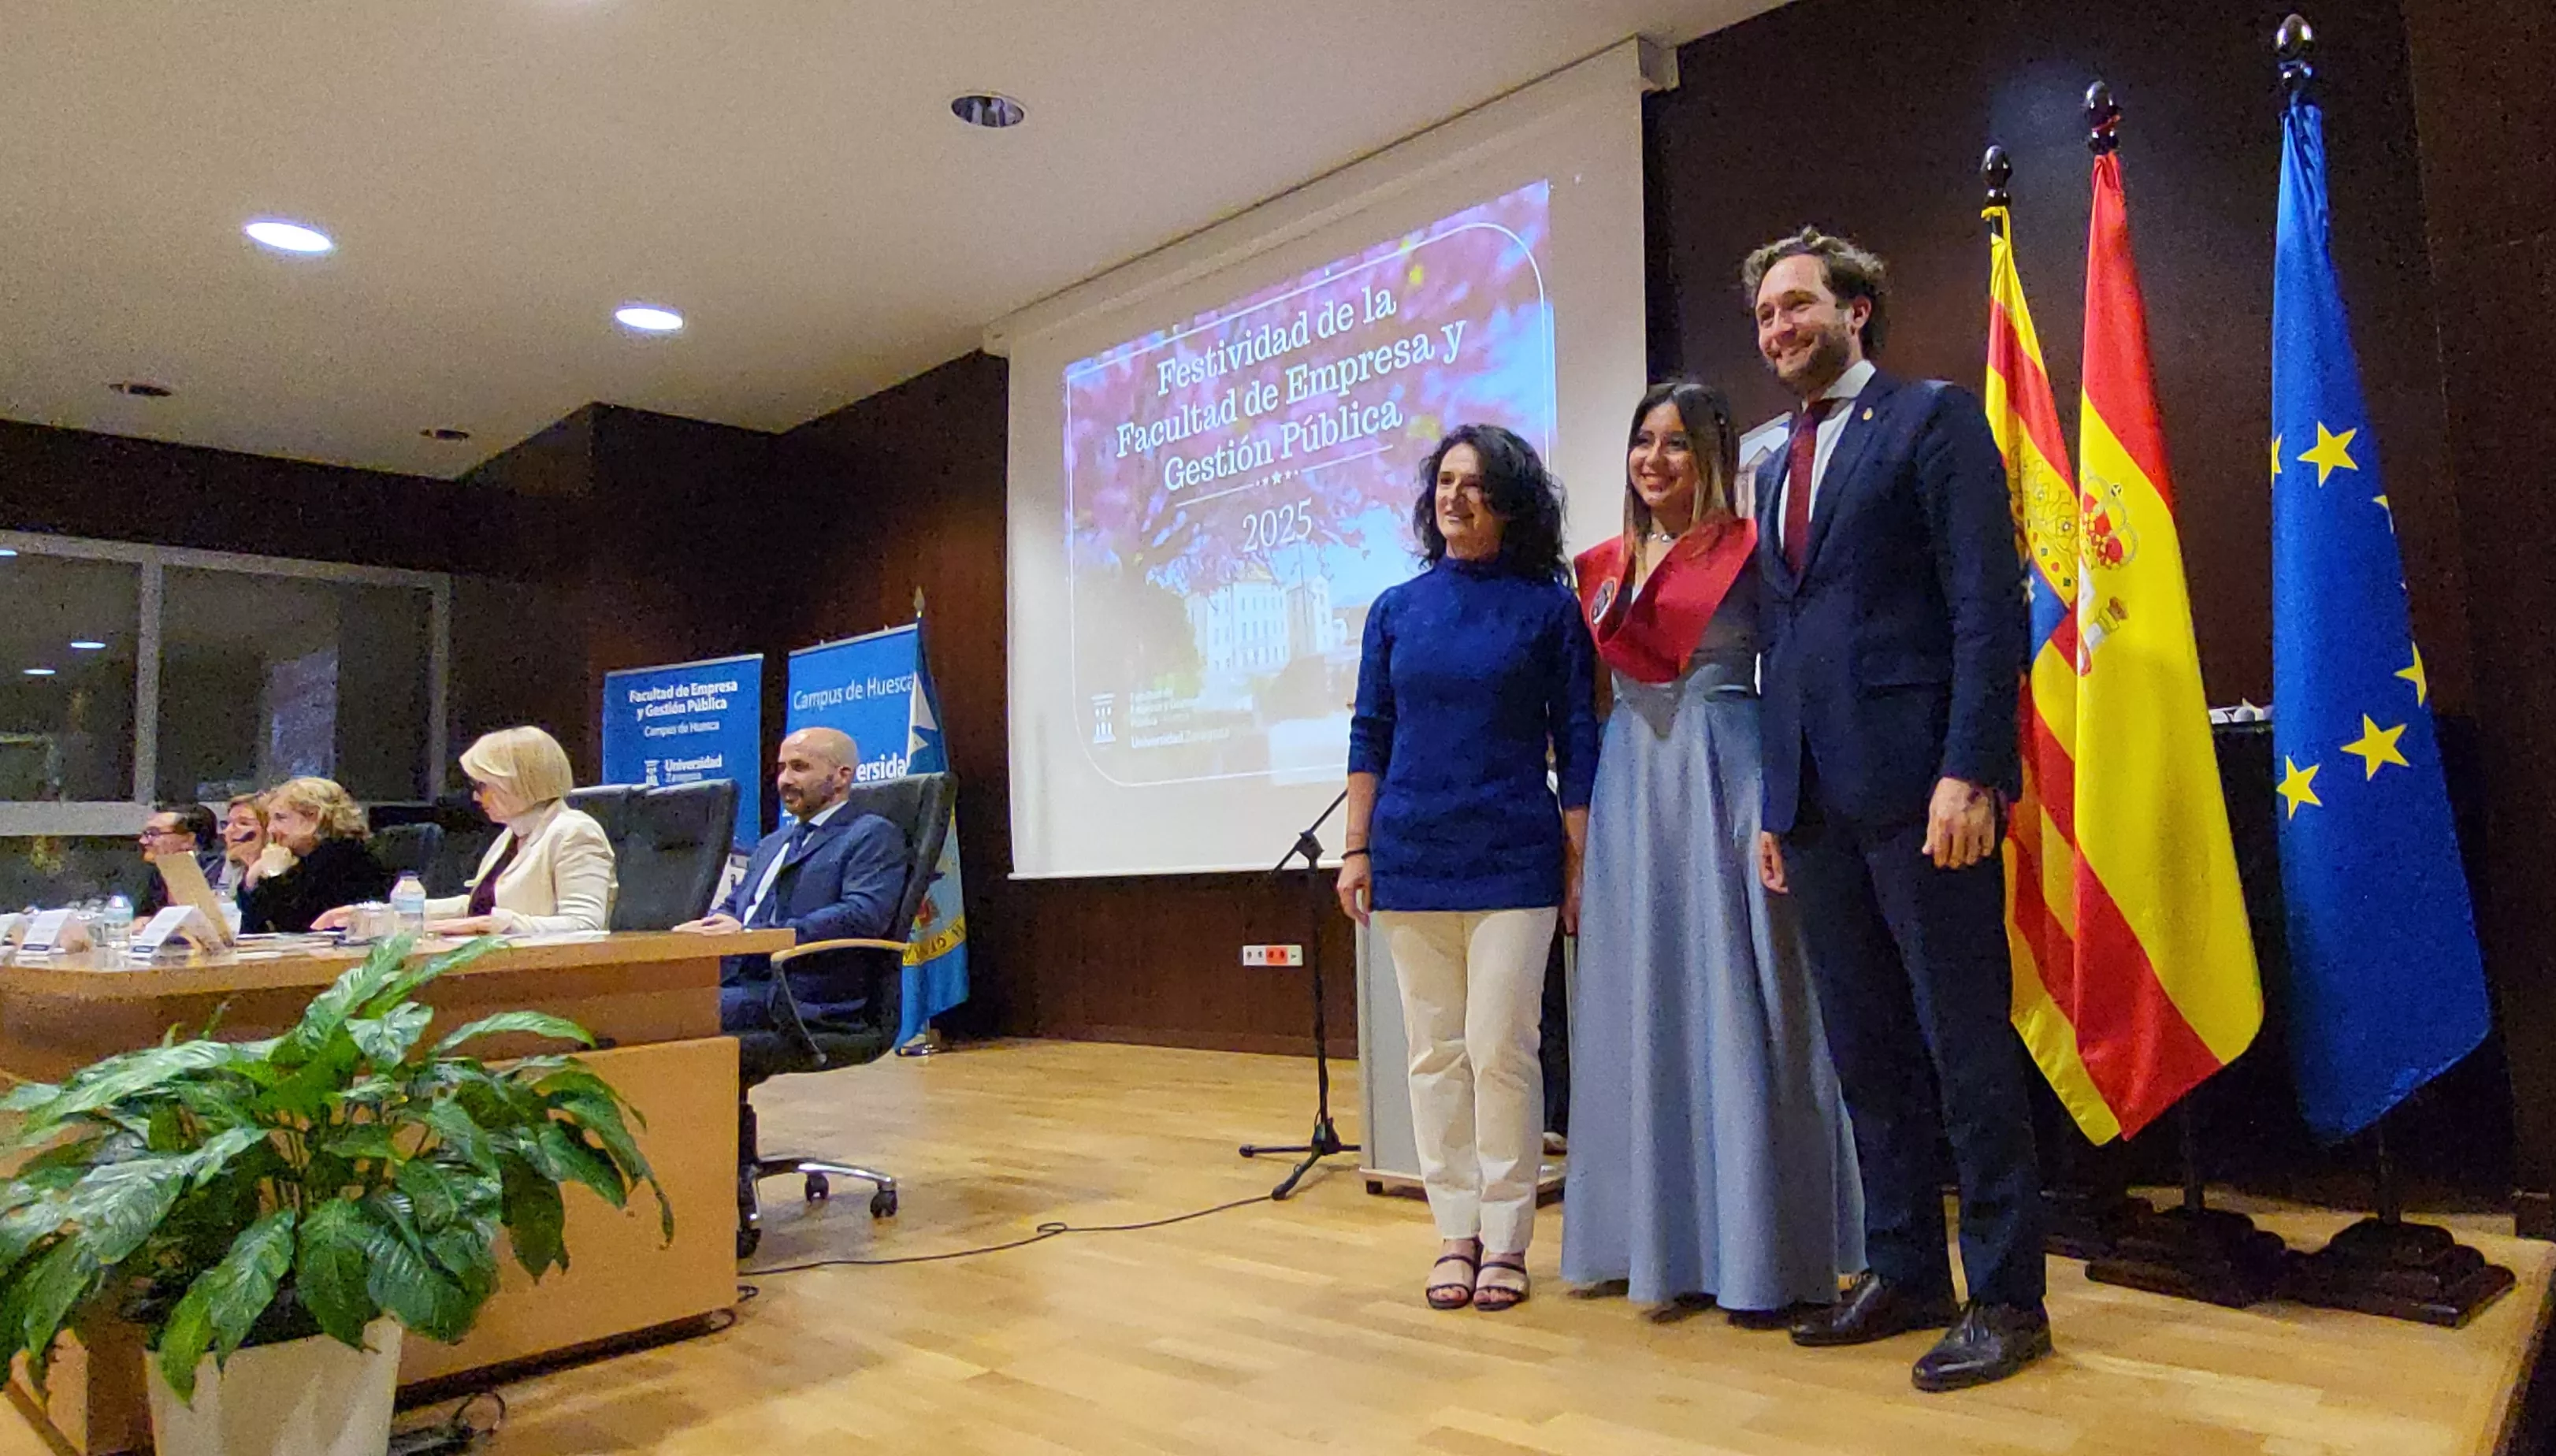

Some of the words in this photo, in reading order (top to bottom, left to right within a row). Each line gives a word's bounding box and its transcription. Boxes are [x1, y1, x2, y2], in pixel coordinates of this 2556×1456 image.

[1157, 310, 1310, 396] Festividad
[1317, 299, 1354, 339] de
[1362, 285, 1397, 325] la
[1116, 388, 1239, 458] Facultad
[1244, 381, 1279, 417] de
[1286, 333, 1435, 405] Empresa
[1441, 320, 1466, 364] y
[1165, 434, 1275, 492] Gestión
[1280, 400, 1402, 459] Pública
[1242, 497, 1312, 552] 2025
[629, 685, 674, 703] Facultad
[675, 684, 689, 697] de
[690, 681, 738, 698] Empresa
[637, 708, 645, 722] y
[645, 700, 685, 717] Gestión
[687, 697, 727, 713] Pública
[793, 687, 843, 711] Campus
[845, 679, 863, 700] de
[856, 751, 907, 782] ersida
